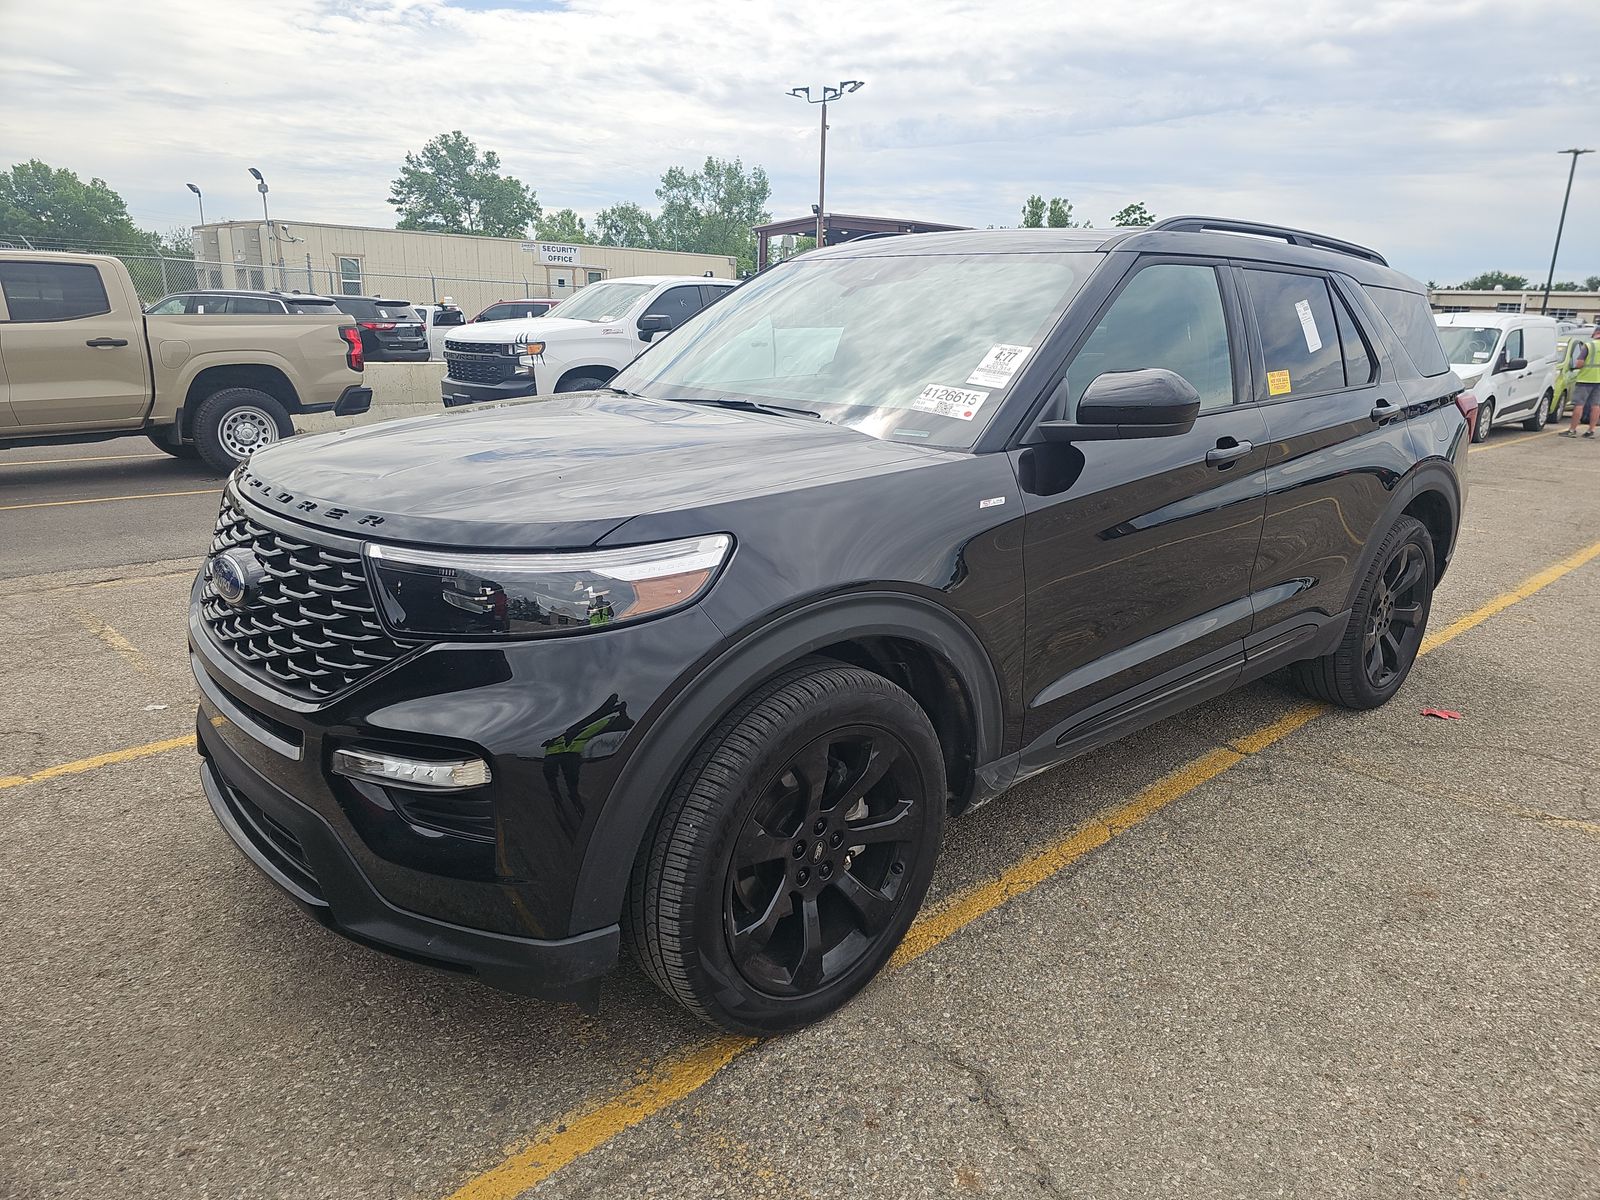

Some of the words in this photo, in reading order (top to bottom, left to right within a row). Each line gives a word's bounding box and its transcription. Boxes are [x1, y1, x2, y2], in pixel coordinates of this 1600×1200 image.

[542, 245, 578, 254] SECURITY
[547, 254, 573, 263] OFFICE
[994, 350, 1019, 363] 4:77
[922, 387, 981, 406] 4126615
